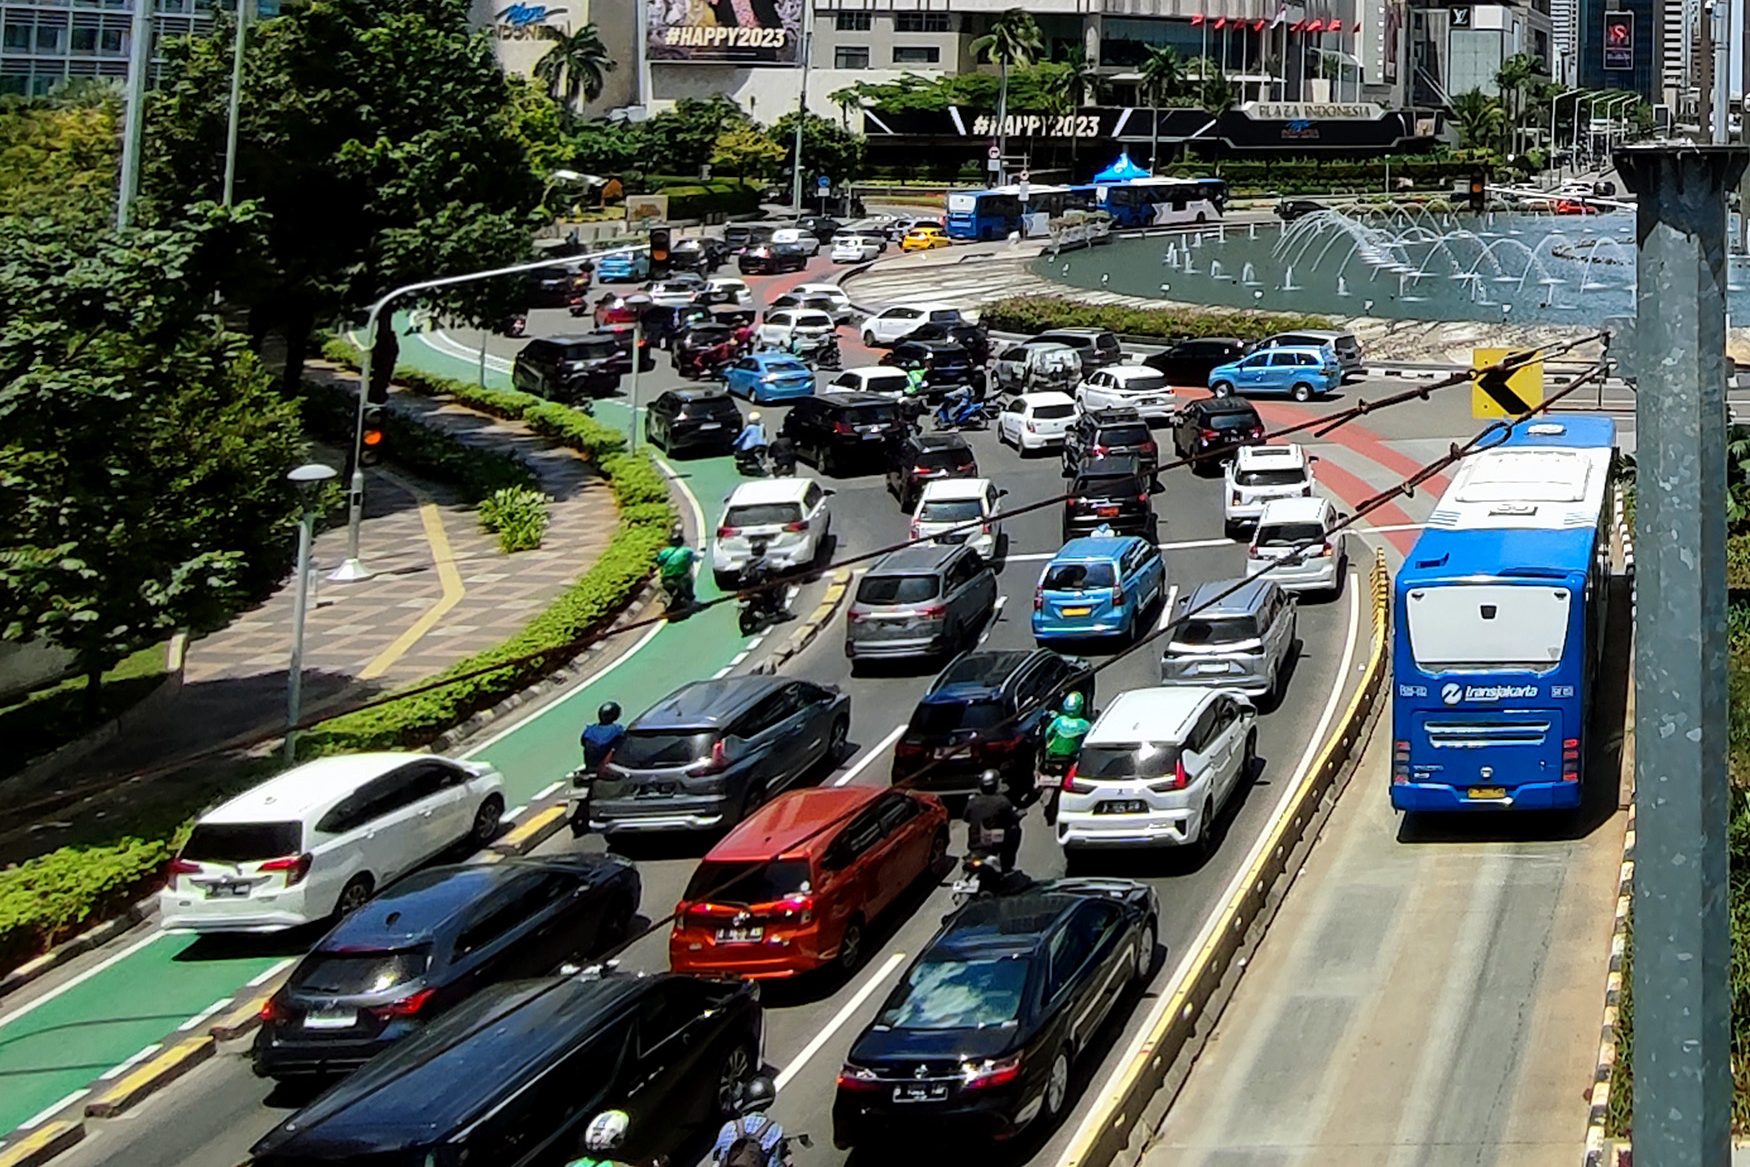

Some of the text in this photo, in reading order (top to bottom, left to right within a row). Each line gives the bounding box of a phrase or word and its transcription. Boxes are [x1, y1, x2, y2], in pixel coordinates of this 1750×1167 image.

[665, 26, 786, 48] #HAPPY2023
[1258, 105, 1370, 118] PLAZA INDONESIA
[1465, 685, 1538, 701] transjakarta
